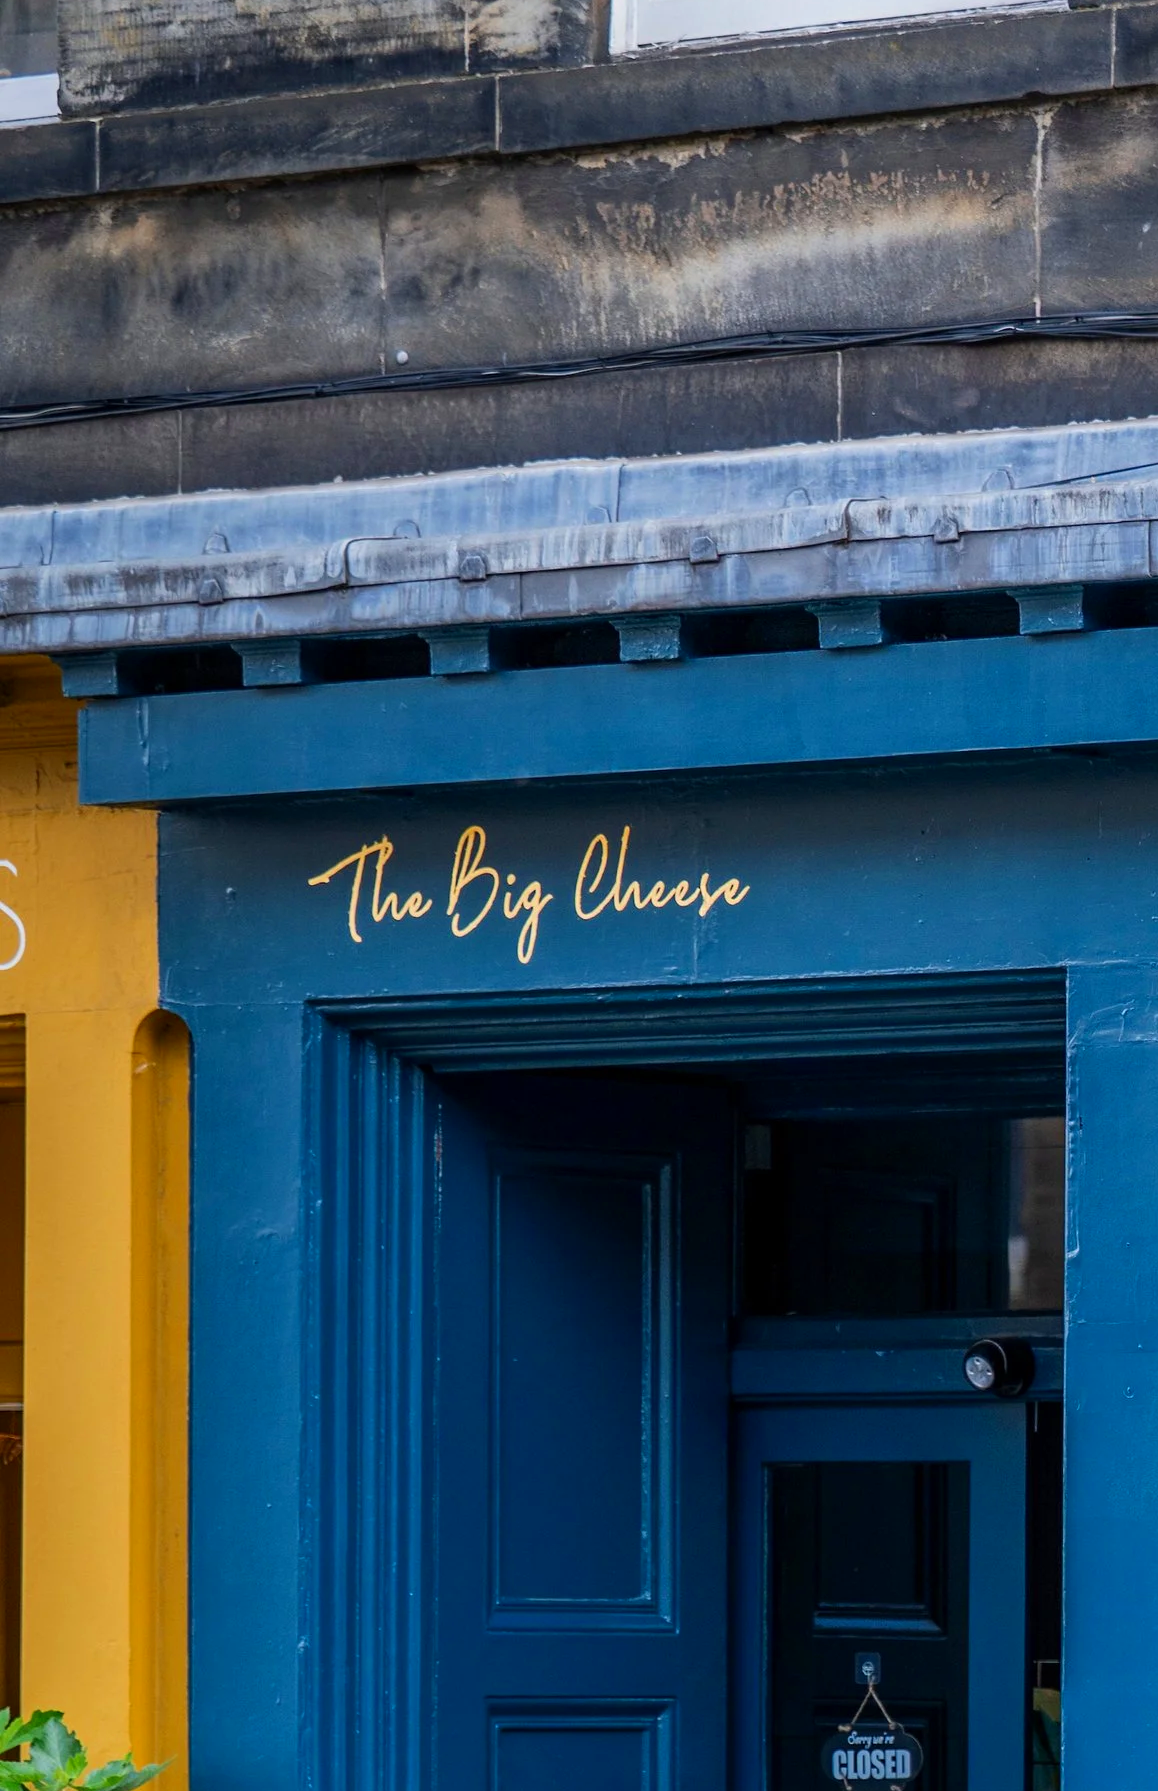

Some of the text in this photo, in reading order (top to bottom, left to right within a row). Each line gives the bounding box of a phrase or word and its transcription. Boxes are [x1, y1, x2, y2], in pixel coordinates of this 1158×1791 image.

[308, 825, 750, 964] The Big Cheese
[832, 1749, 912, 1780] CLOSED
